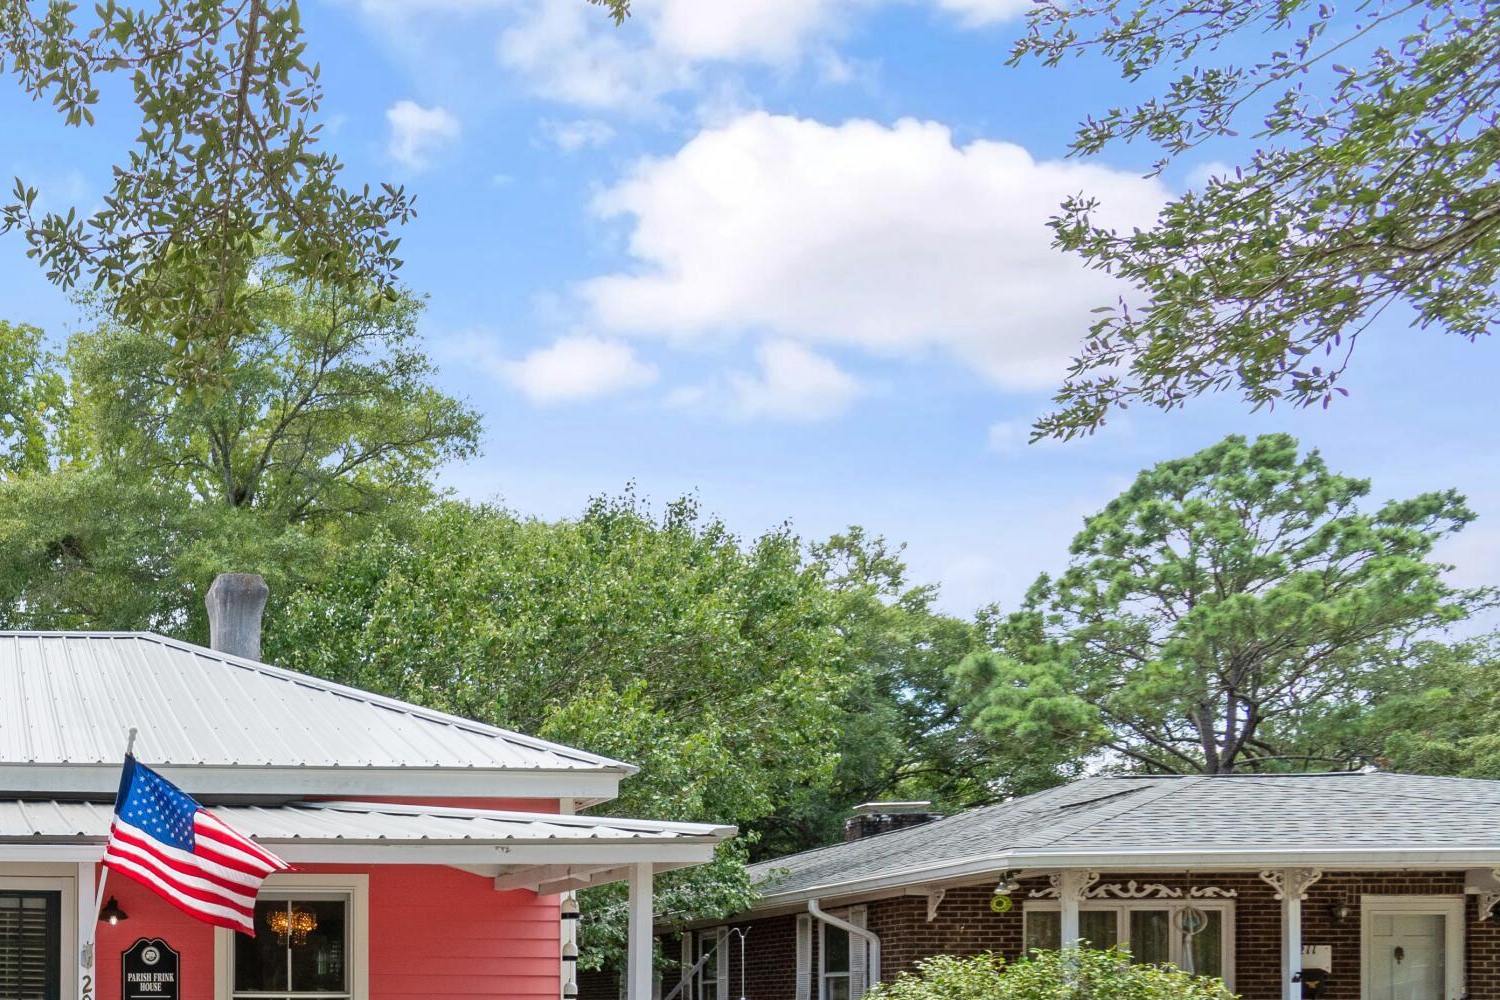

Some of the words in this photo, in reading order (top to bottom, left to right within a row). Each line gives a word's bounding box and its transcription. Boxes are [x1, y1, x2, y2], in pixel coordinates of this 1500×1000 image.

[127, 972, 152, 982] PARISH
[153, 972, 175, 982] FRINK
[139, 982, 162, 992] HOUSE
